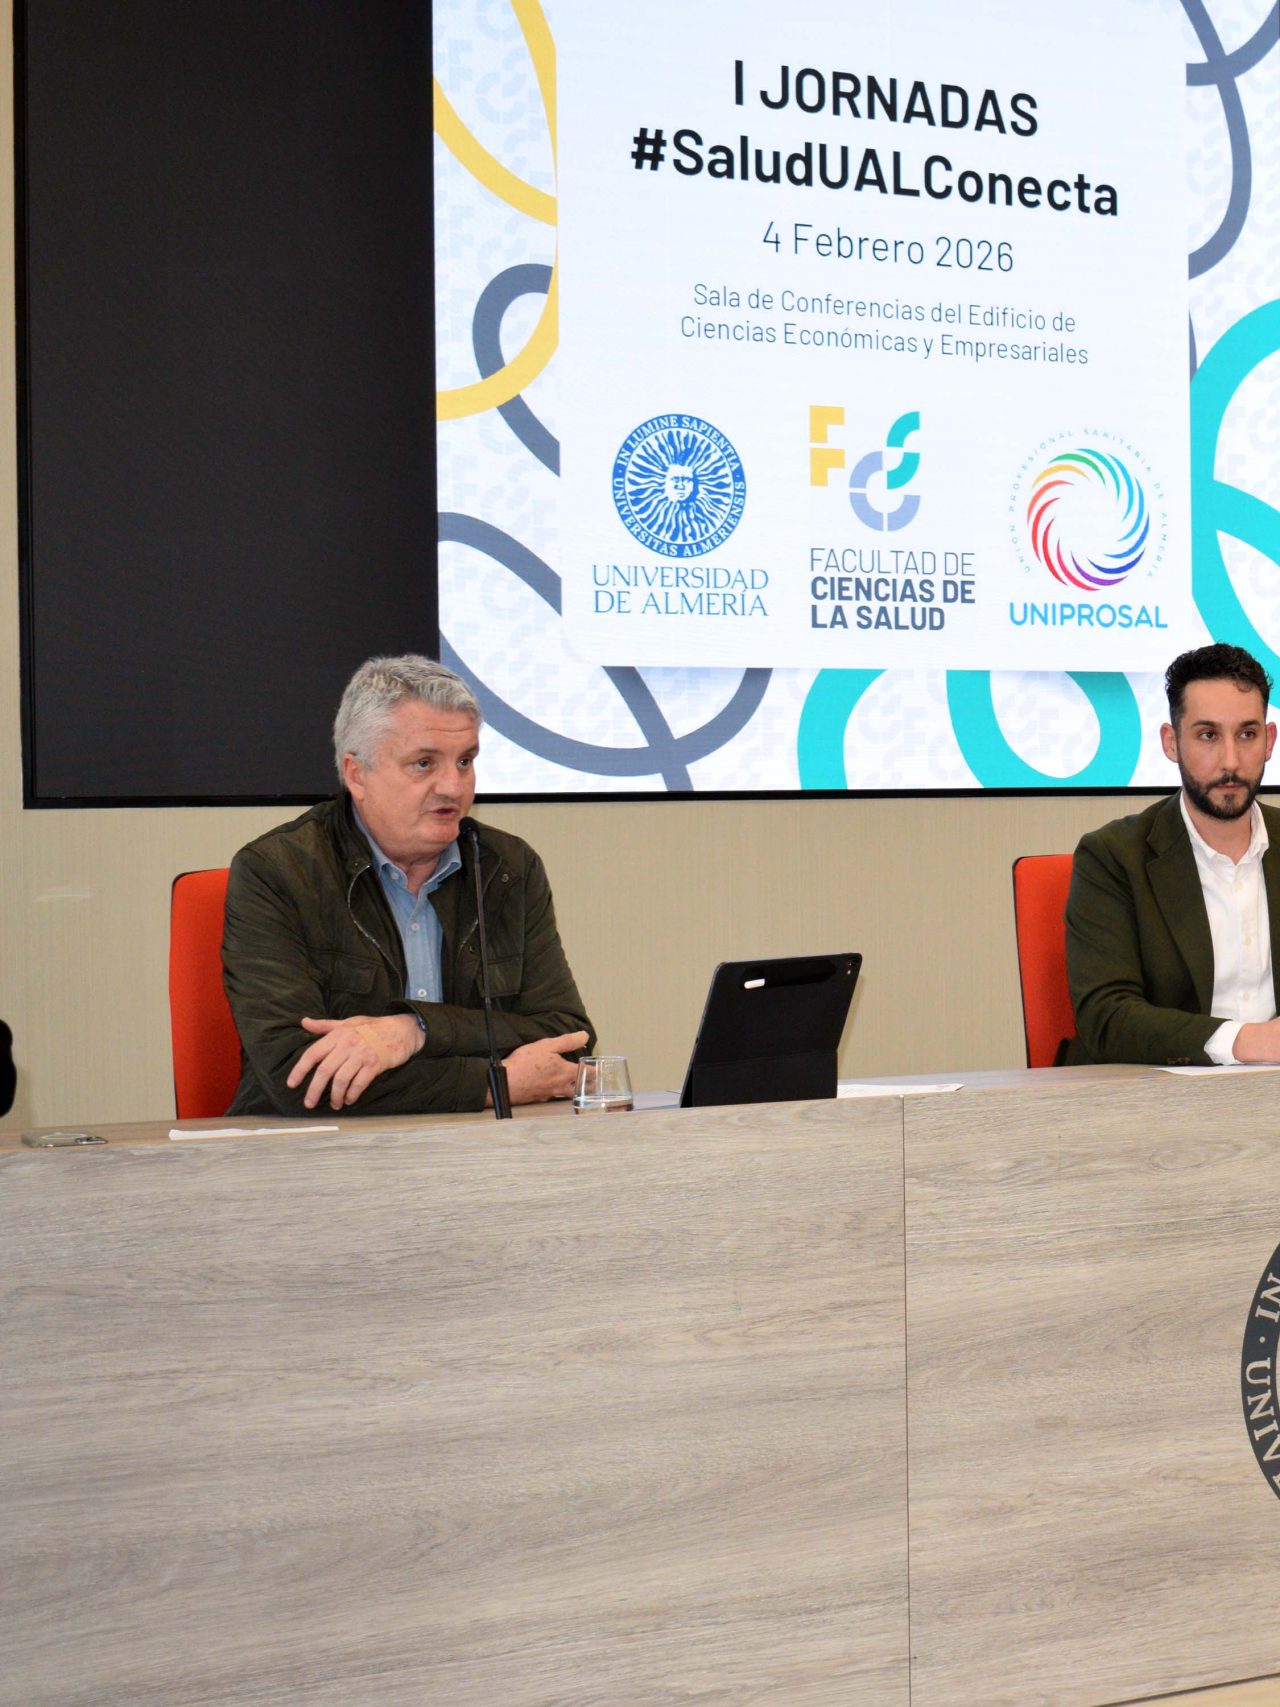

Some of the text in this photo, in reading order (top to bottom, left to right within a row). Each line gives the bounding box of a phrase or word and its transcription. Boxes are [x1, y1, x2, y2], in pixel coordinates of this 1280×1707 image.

[734, 60, 1039, 137] I JORNADAS
[631, 125, 1118, 216] #SaludUALConecta
[763, 221, 1013, 273] 4 Febrero 2026
[694, 283, 1076, 332] Sala de Conferencias del Edificio de
[681, 316, 1089, 365] Ciencias Económicas y Empresariales
[616, 415, 741, 472] IN LUMINE SAPIENTIA
[613, 477, 745, 557] UNIVERSITAS ALMERIENSIS
[592, 564, 769, 590] UNIVERSIDAD
[810, 548, 975, 576] FACULTAD DE
[594, 589, 769, 616] DE ALMERÍA
[811, 576, 975, 604] CIENCIAS DE
[811, 604, 945, 631] LA SALUD
[1010, 602, 1168, 629] UNIPROSAL
